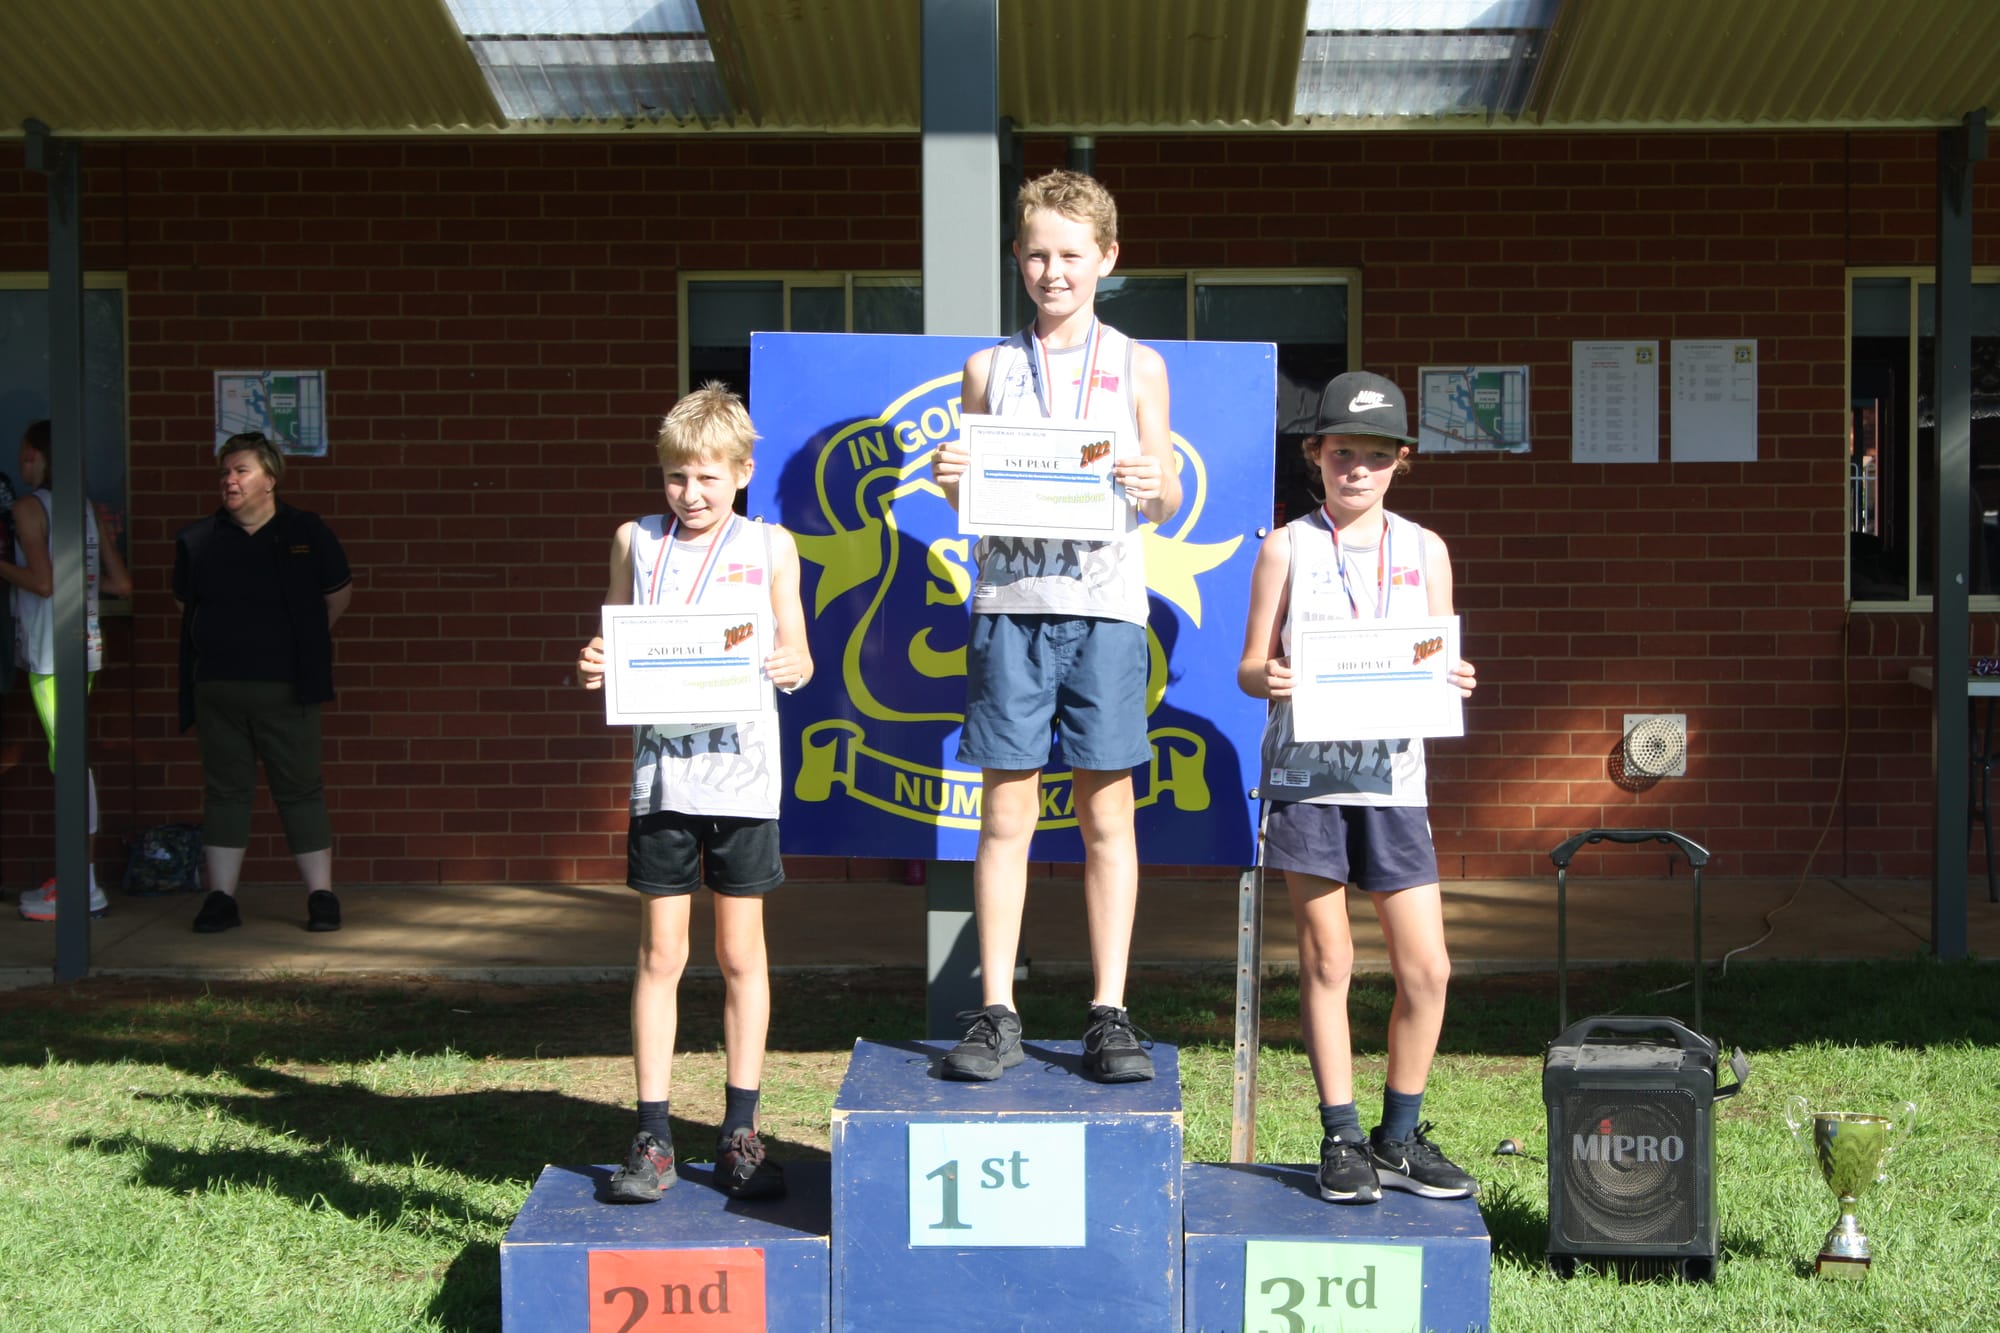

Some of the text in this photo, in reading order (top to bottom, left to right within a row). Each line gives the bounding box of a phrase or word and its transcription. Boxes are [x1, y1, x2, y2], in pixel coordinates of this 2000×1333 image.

[1356, 390, 1385, 403] NIKE
[848, 431, 889, 470] IN
[1005, 458, 1060, 470] 1ST PLACE
[1080, 440, 1111, 469] 2022
[647, 646, 705, 656] 2ND PLACE
[724, 622, 754, 652] 2022
[1412, 637, 1443, 665] 2022
[926, 1151, 1030, 1229] 1st
[604, 1271, 731, 1333] 2nd
[1260, 1265, 1378, 1333] 3rd
